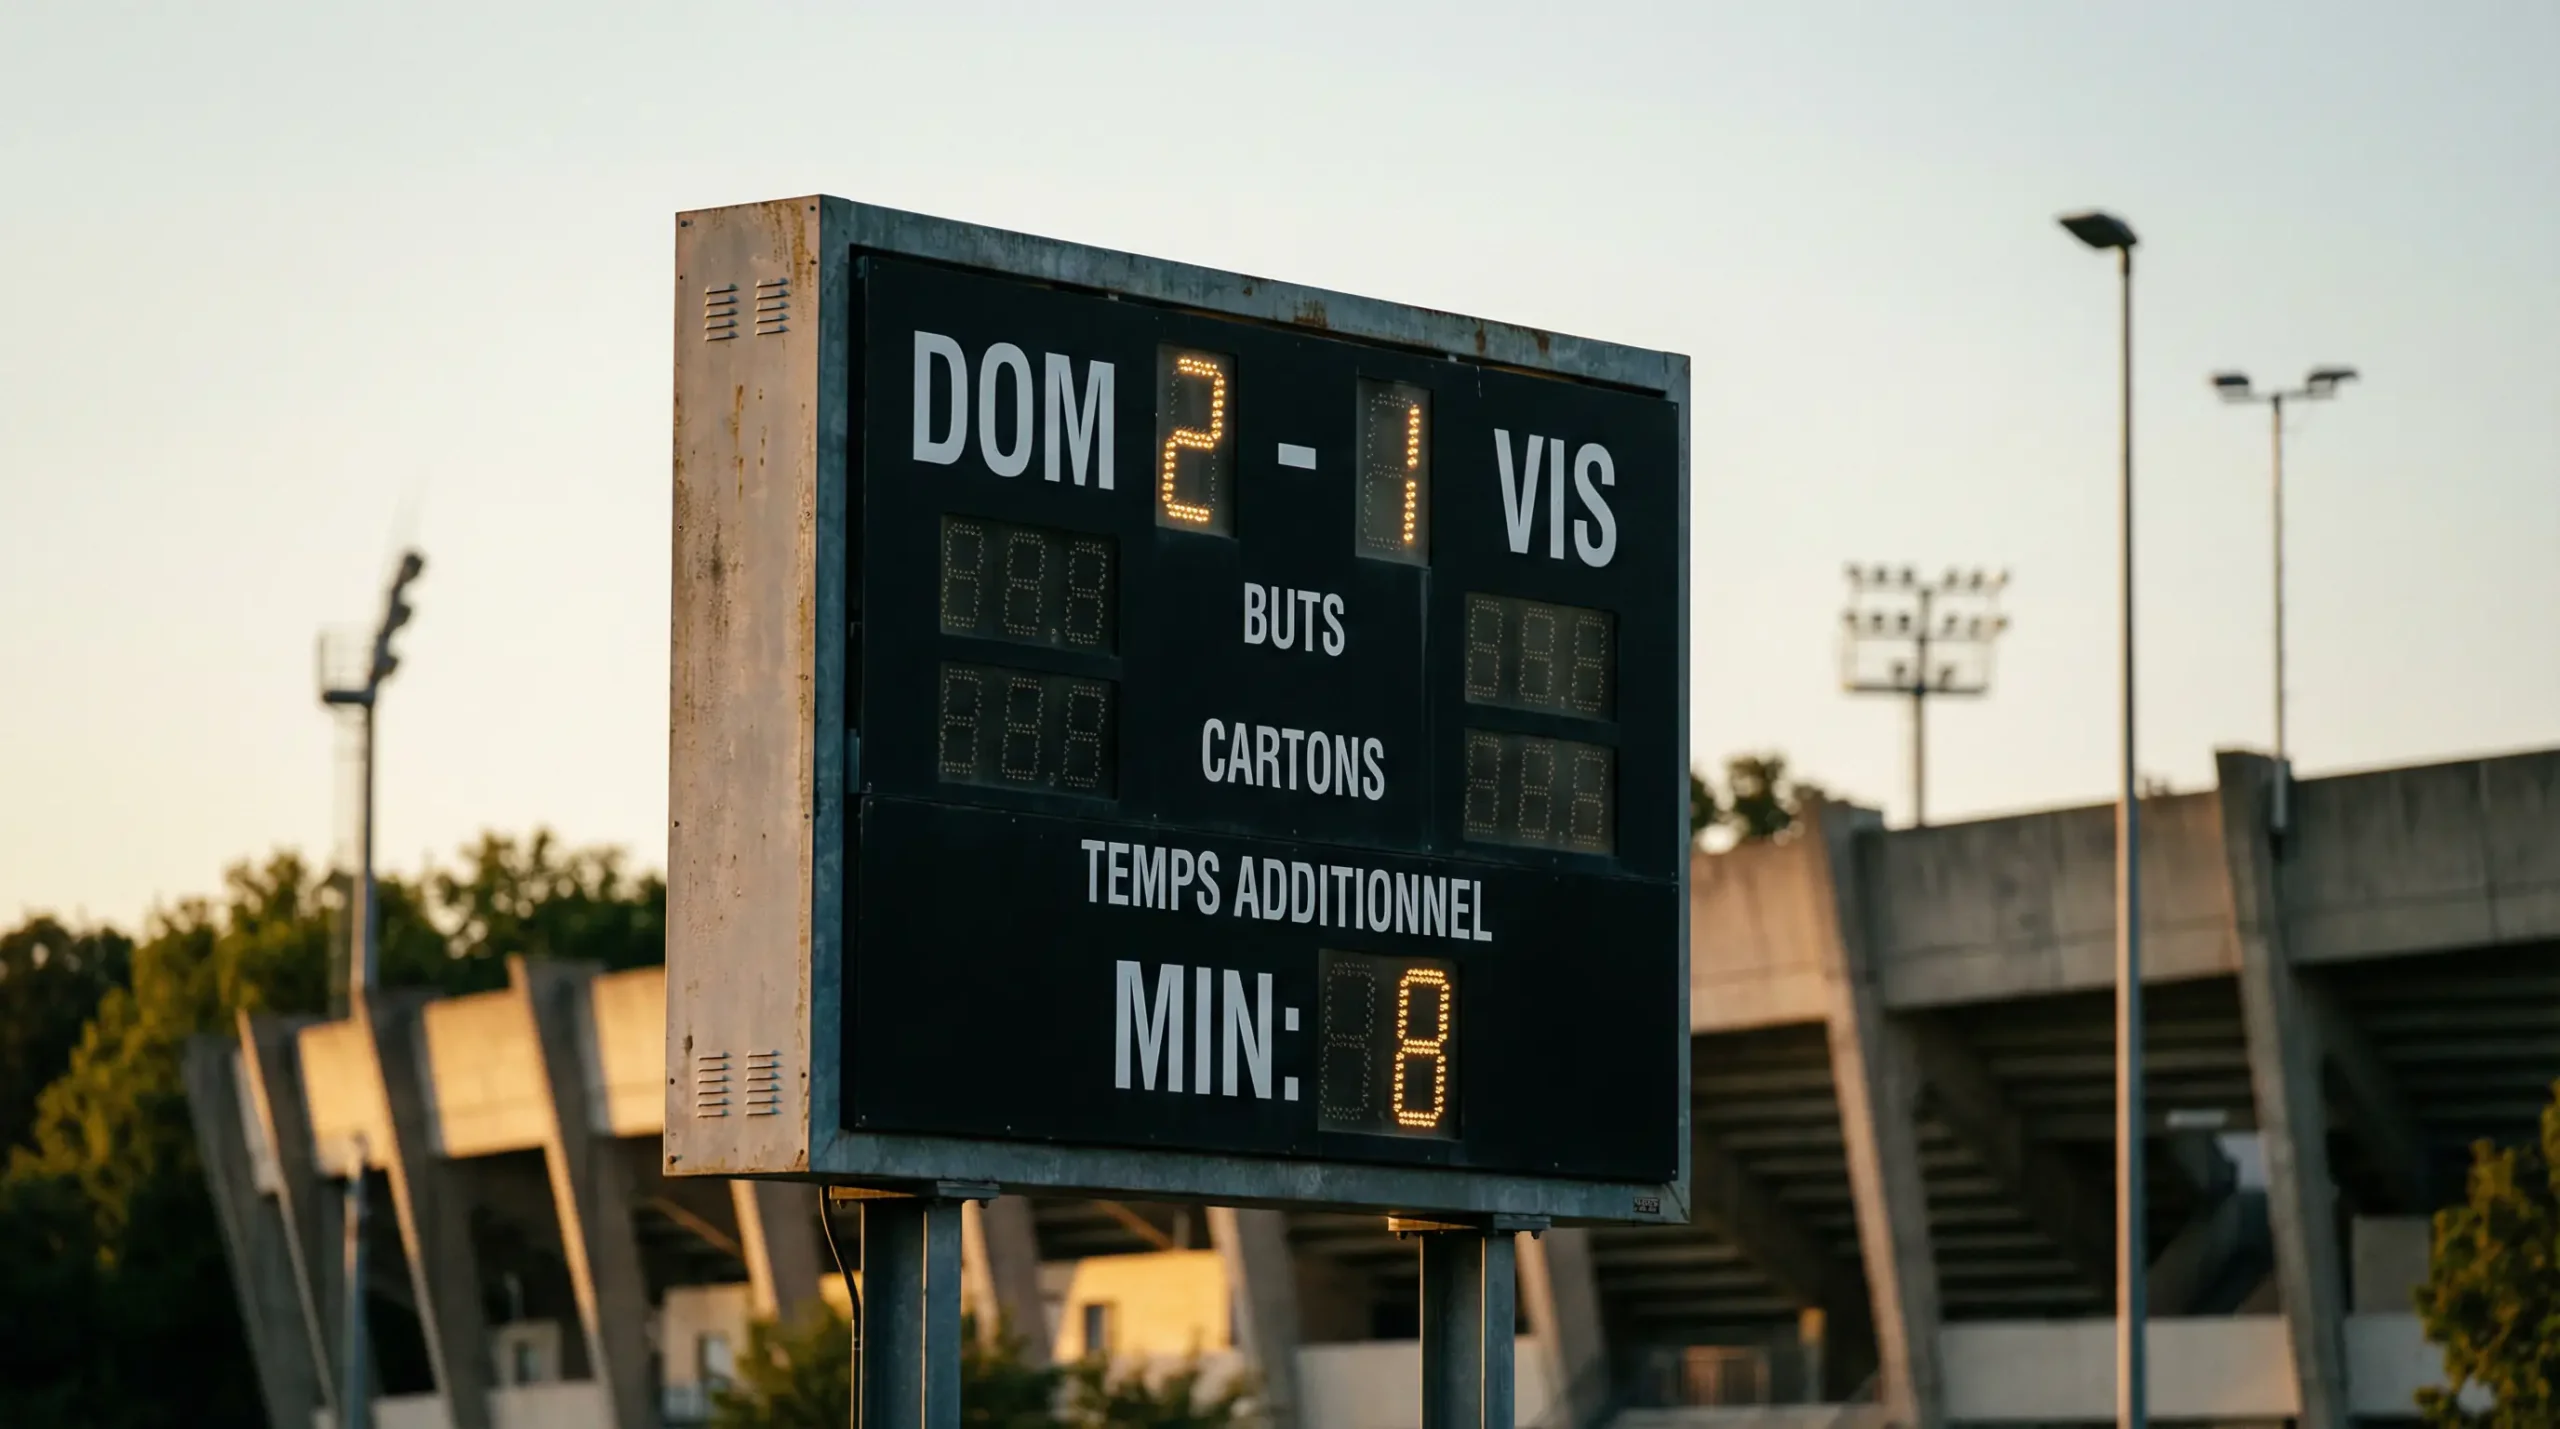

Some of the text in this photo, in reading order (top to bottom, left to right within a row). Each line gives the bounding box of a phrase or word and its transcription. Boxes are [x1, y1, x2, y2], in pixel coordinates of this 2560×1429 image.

[913, 331, 1115, 490] DOM
[1161, 355, 1226, 525] 2
[1402, 403, 1422, 545] 1
[1494, 429, 1617, 568] VIS
[1244, 582, 1345, 657] BUTS
[1202, 718, 1385, 801] CARTONS
[1081, 839, 1493, 942] TEMPS ADDITIONNEL
[1115, 959, 1450, 1128] MIN: 8
